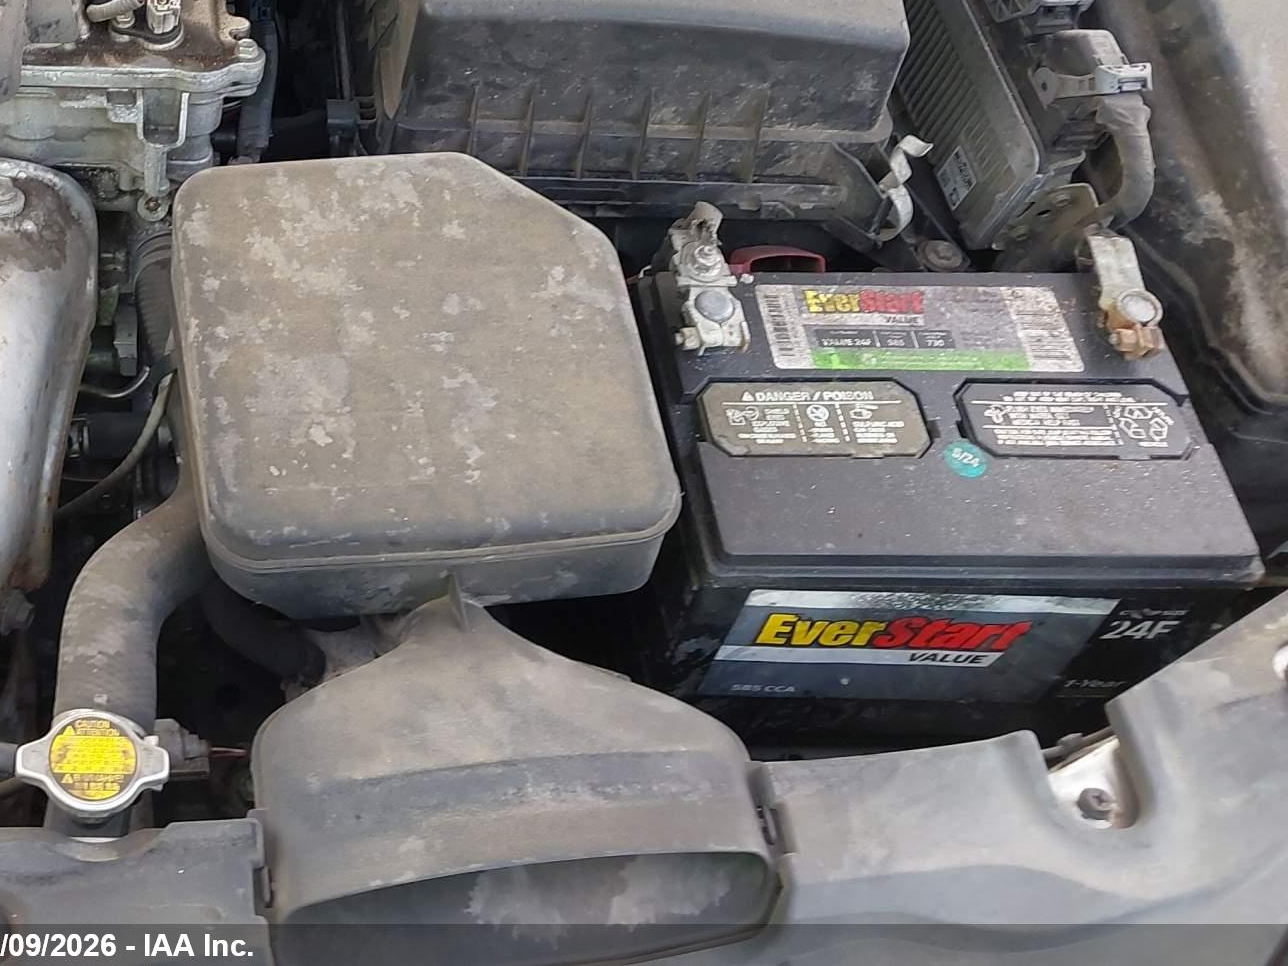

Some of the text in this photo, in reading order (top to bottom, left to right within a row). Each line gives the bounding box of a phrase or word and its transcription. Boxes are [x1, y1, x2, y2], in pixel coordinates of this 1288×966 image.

[803, 289, 924, 314] EverStart
[755, 392, 811, 401] DANGER
[823, 391, 874, 401] POISON
[754, 612, 1034, 651] EverStart
[1099, 620, 1183, 640] 24F
[908, 651, 989, 666] VALUE
[764, 684, 796, 693] CCA
